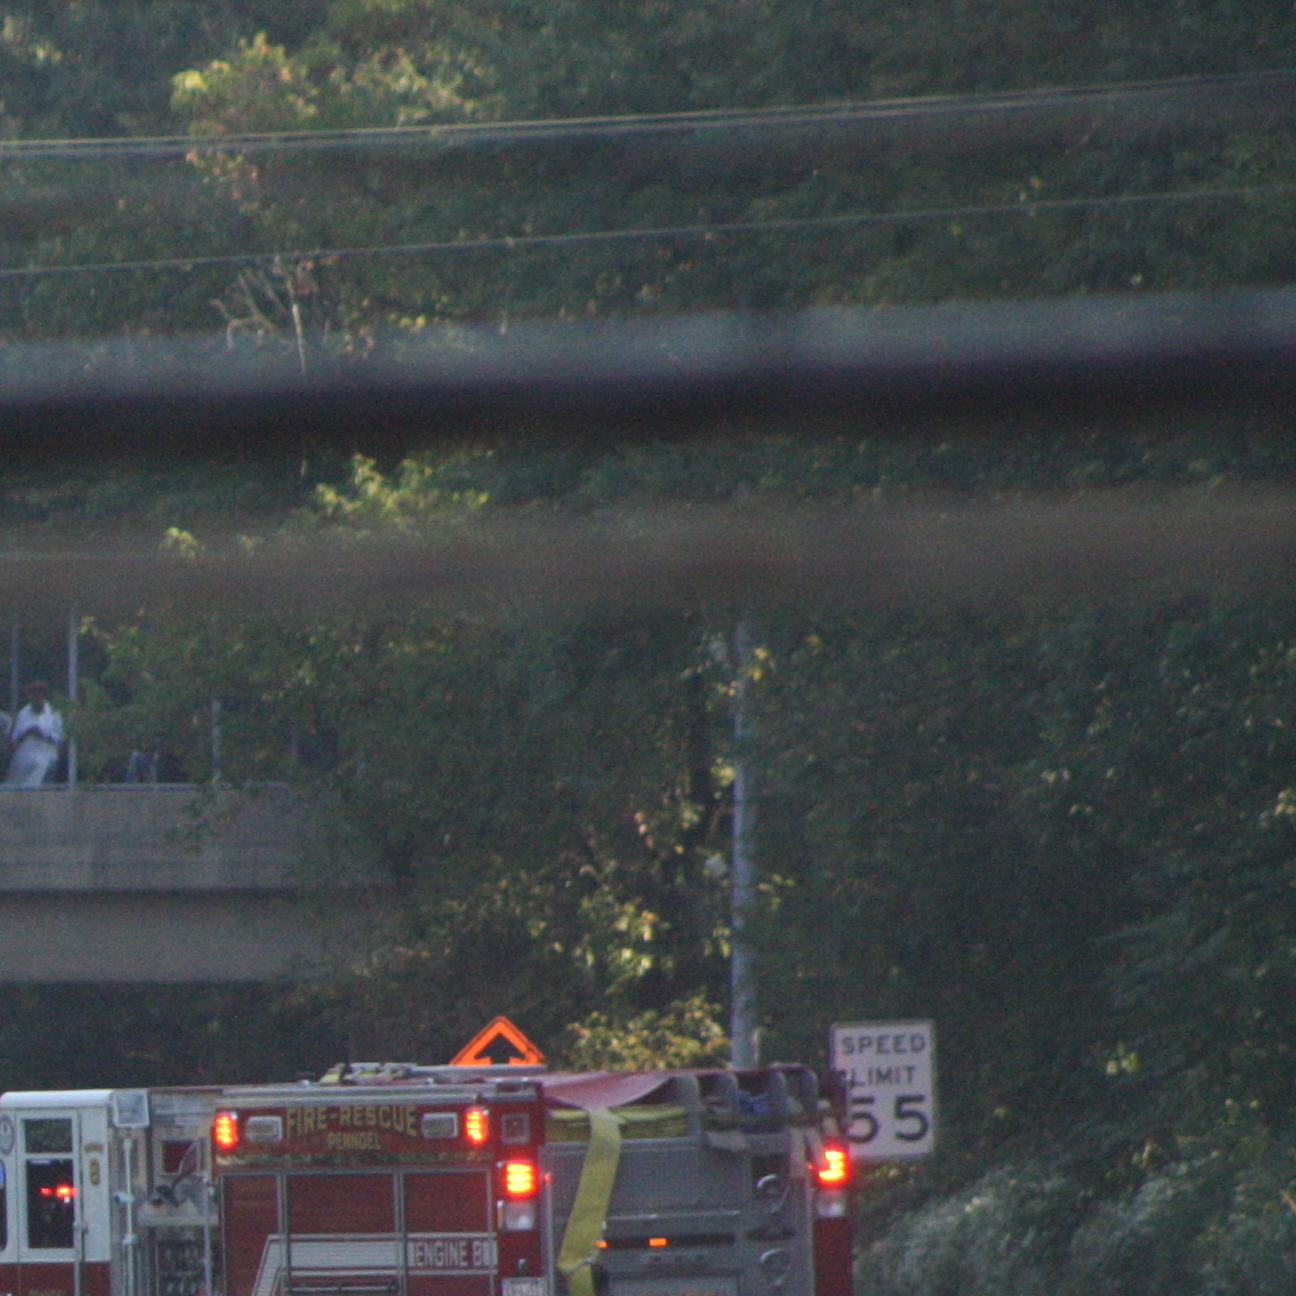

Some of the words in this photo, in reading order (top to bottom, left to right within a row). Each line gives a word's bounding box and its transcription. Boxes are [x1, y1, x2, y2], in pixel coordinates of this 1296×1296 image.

[842, 1033, 926, 1055] SPEED
[849, 1064, 916, 1087] LIMIT
[286, 1105, 418, 1139] FIRE-RESCUE
[847, 1094, 930, 1144] 55
[326, 1131, 381, 1150] PENNDEL
[415, 1240, 469, 1267] ENGINE
